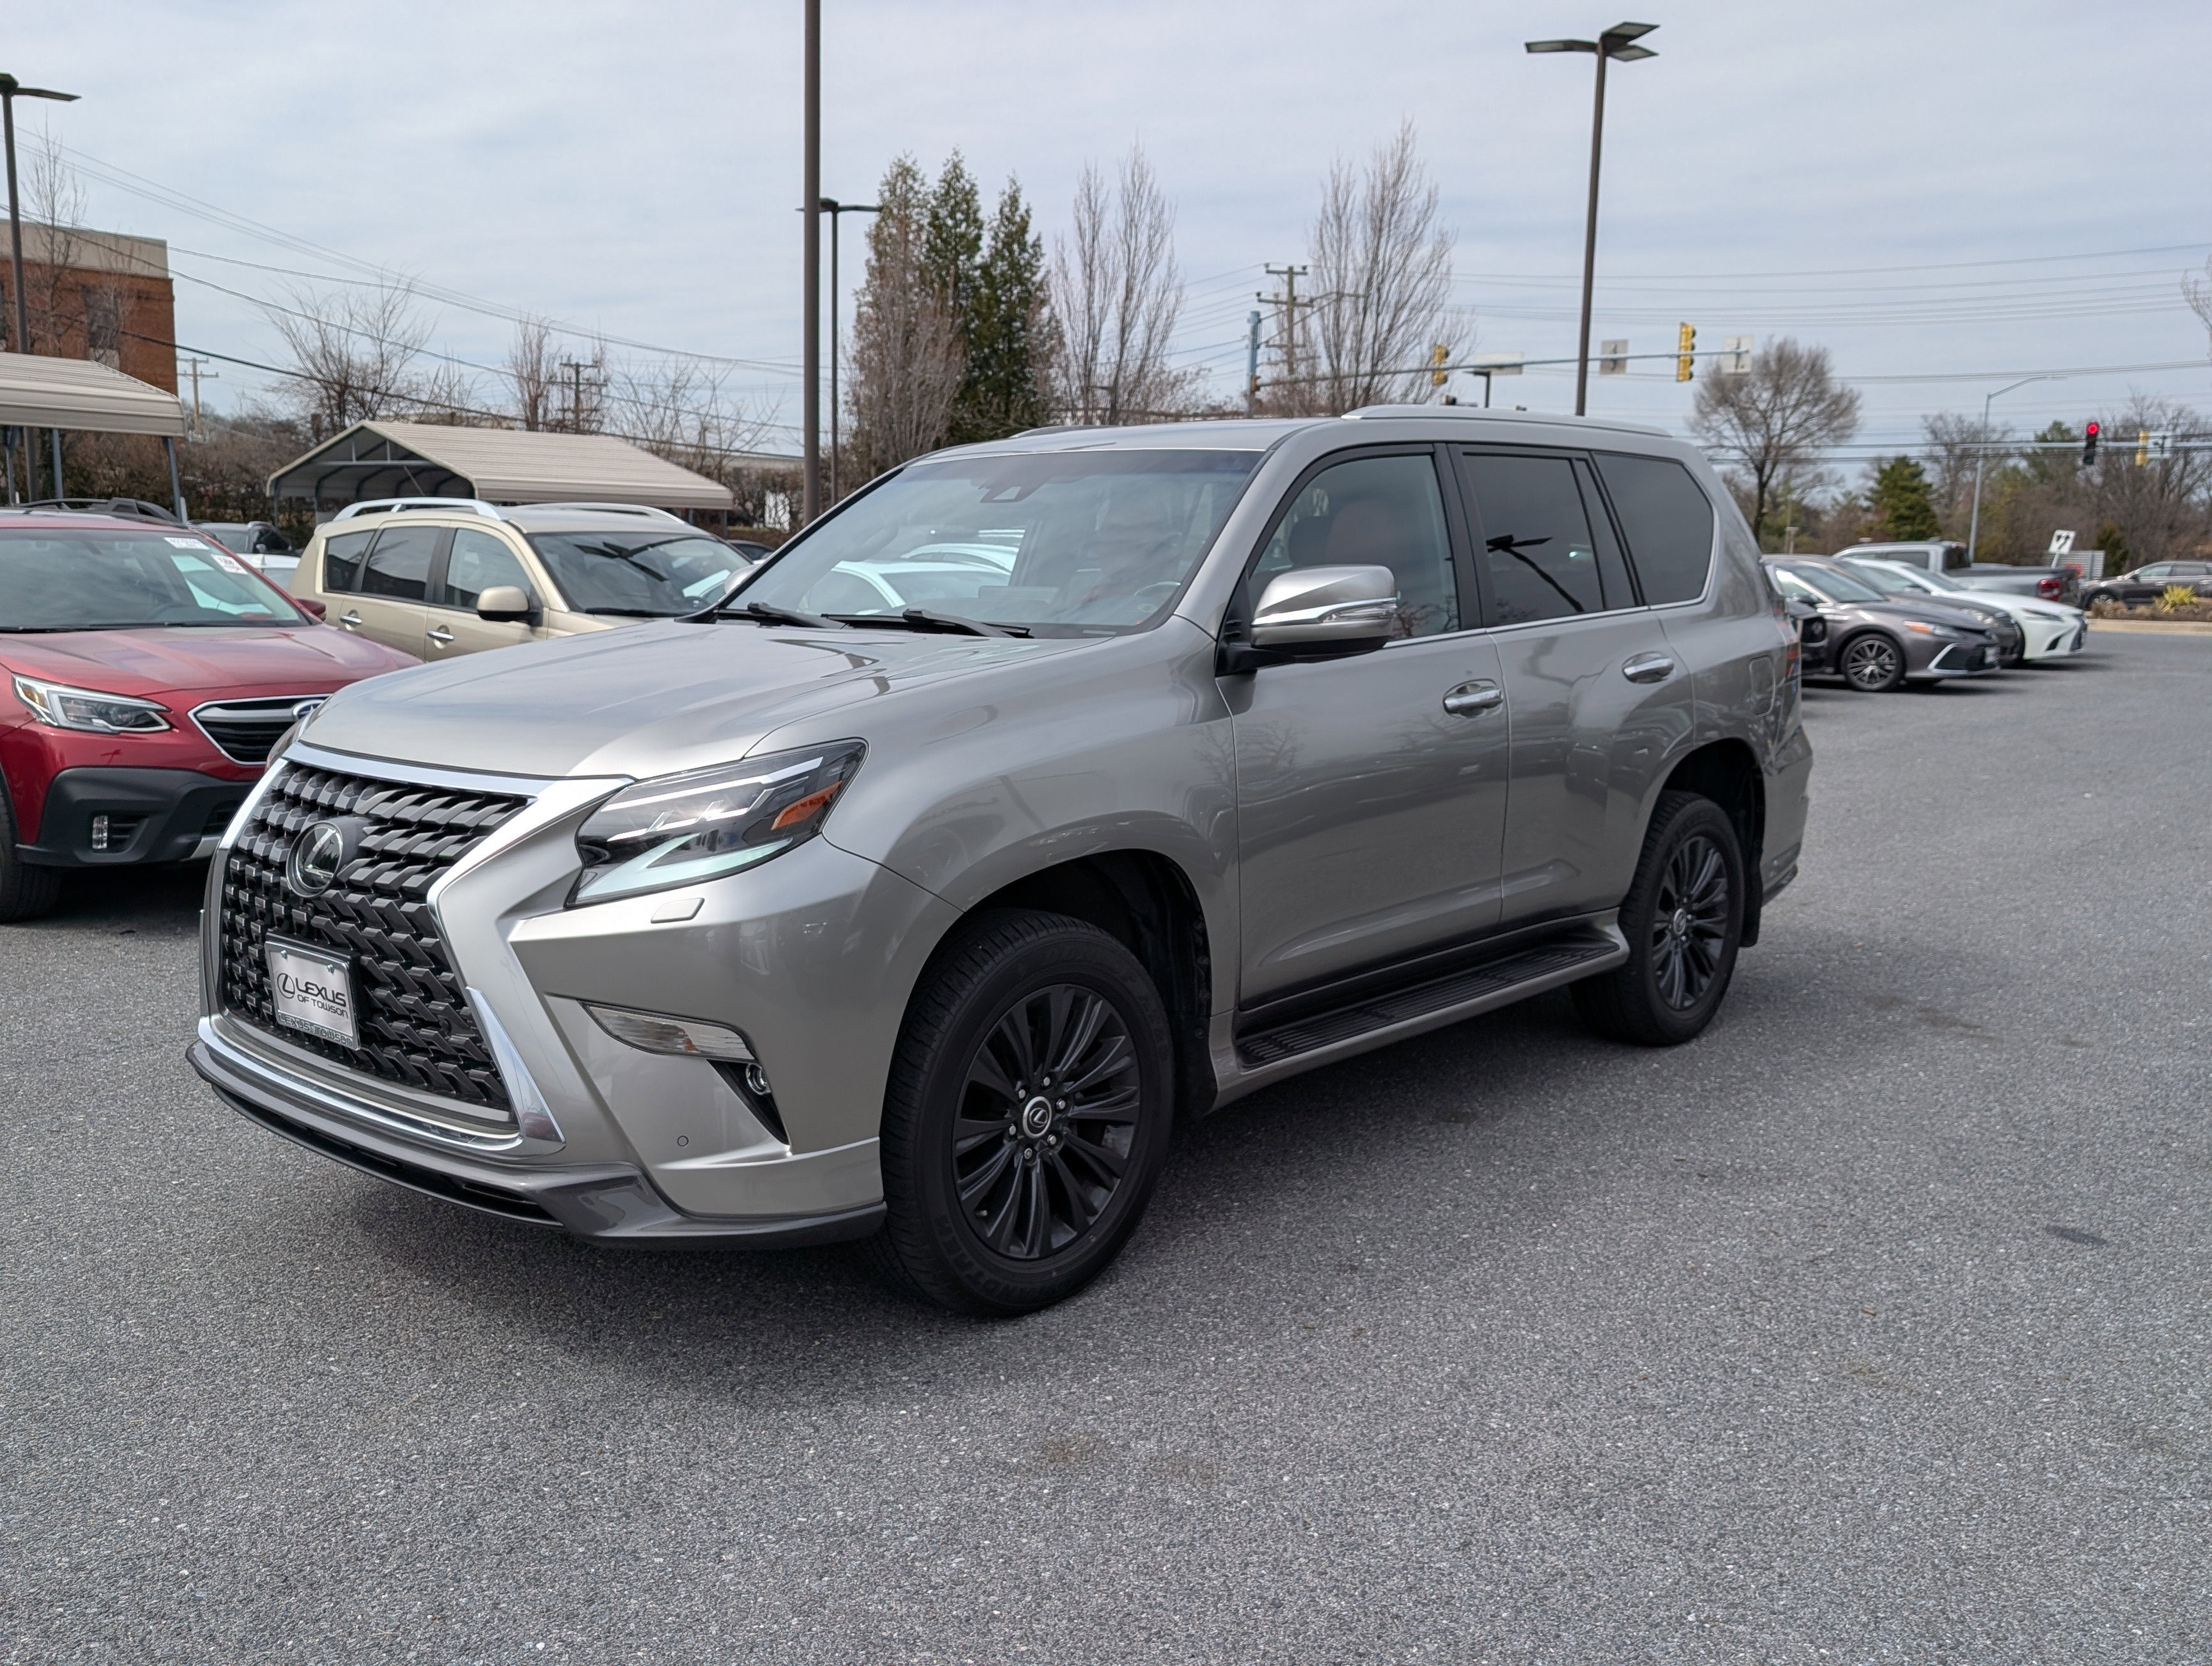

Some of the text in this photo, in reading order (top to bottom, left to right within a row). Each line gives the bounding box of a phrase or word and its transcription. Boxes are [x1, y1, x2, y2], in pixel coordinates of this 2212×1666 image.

[295, 977, 346, 1007] LEXUS
[297, 994, 348, 1018] OF TOWSON
[278, 1013, 311, 1031] LEXUS
